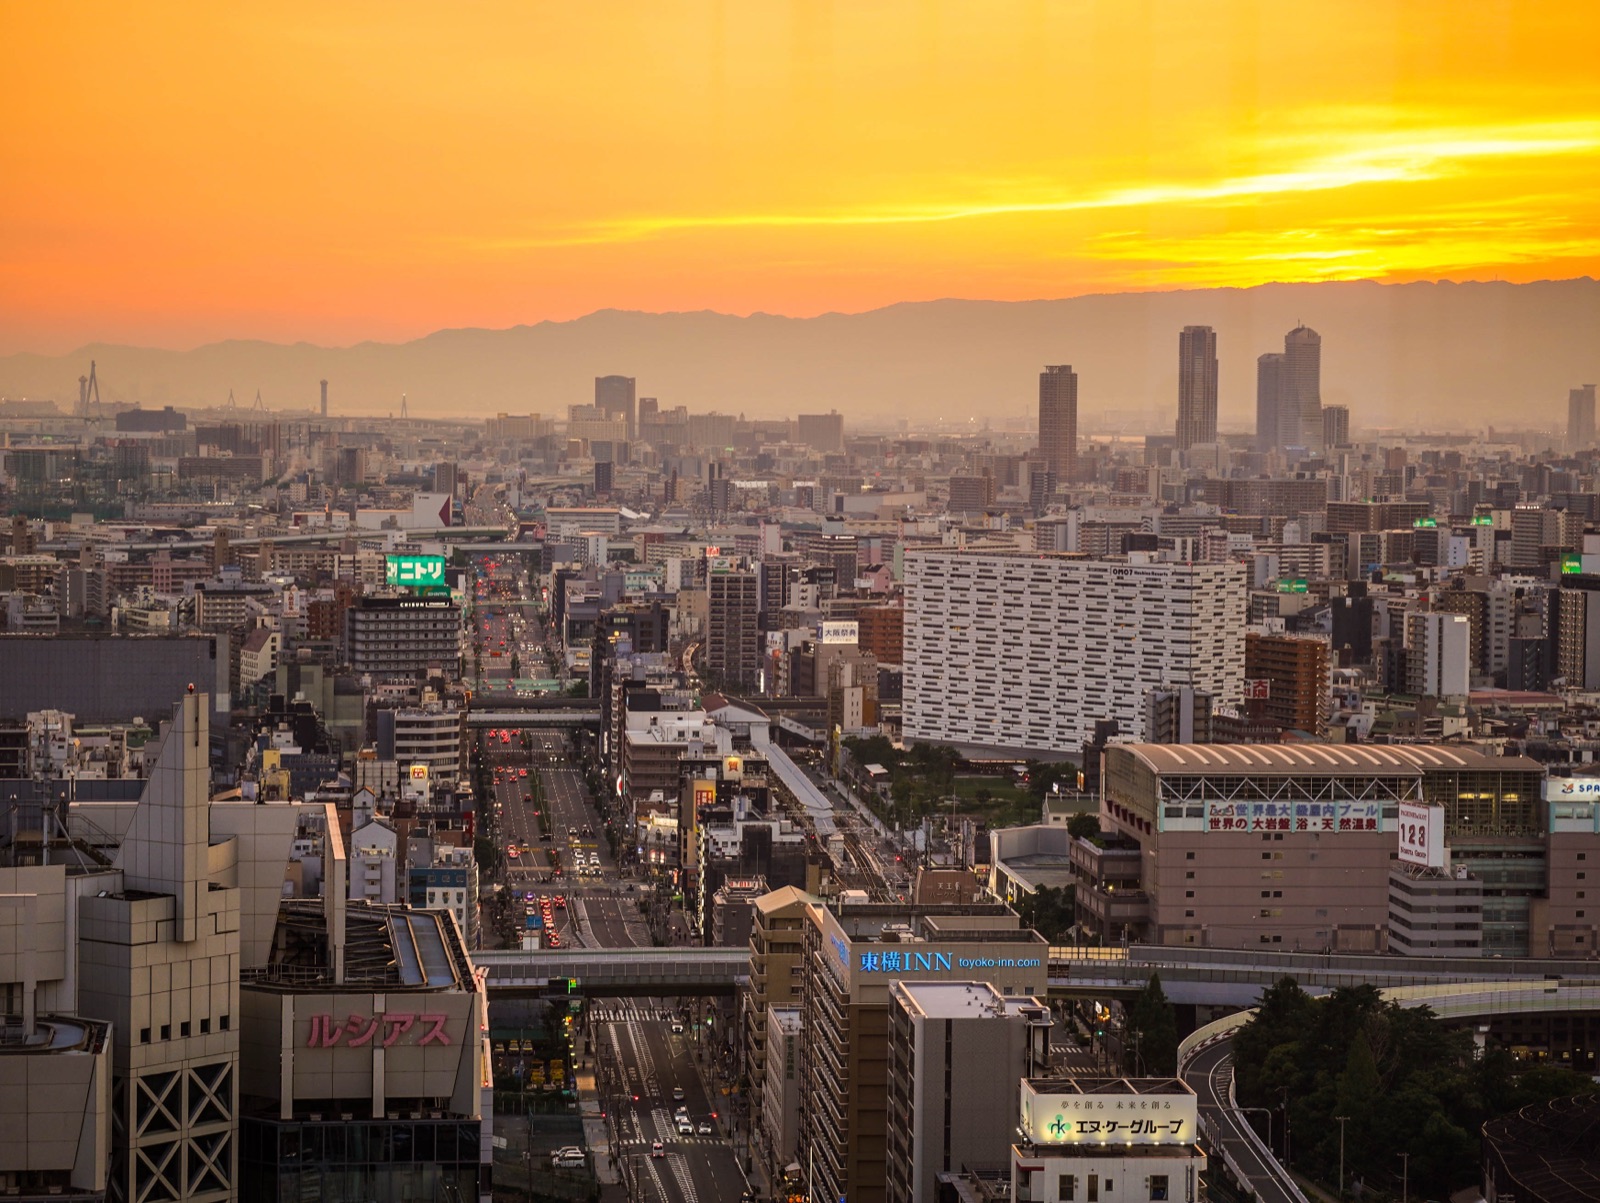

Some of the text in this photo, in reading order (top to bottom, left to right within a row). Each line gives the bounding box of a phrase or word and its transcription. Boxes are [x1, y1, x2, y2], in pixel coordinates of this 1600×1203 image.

[401, 562, 442, 580] ニトリ
[824, 628, 857, 638] 大阪祭典
[1209, 818, 1378, 831] 世界の大岩盤浴・天然温泉
[860, 952, 953, 973] 東横INN
[958, 957, 1041, 970] toyoko-inn.com
[308, 1014, 451, 1047] ルシアス
[1060, 1100, 1172, 1110] 夢を創る 未来を創る
[1076, 1119, 1184, 1134] エヌ・ケーグループ
